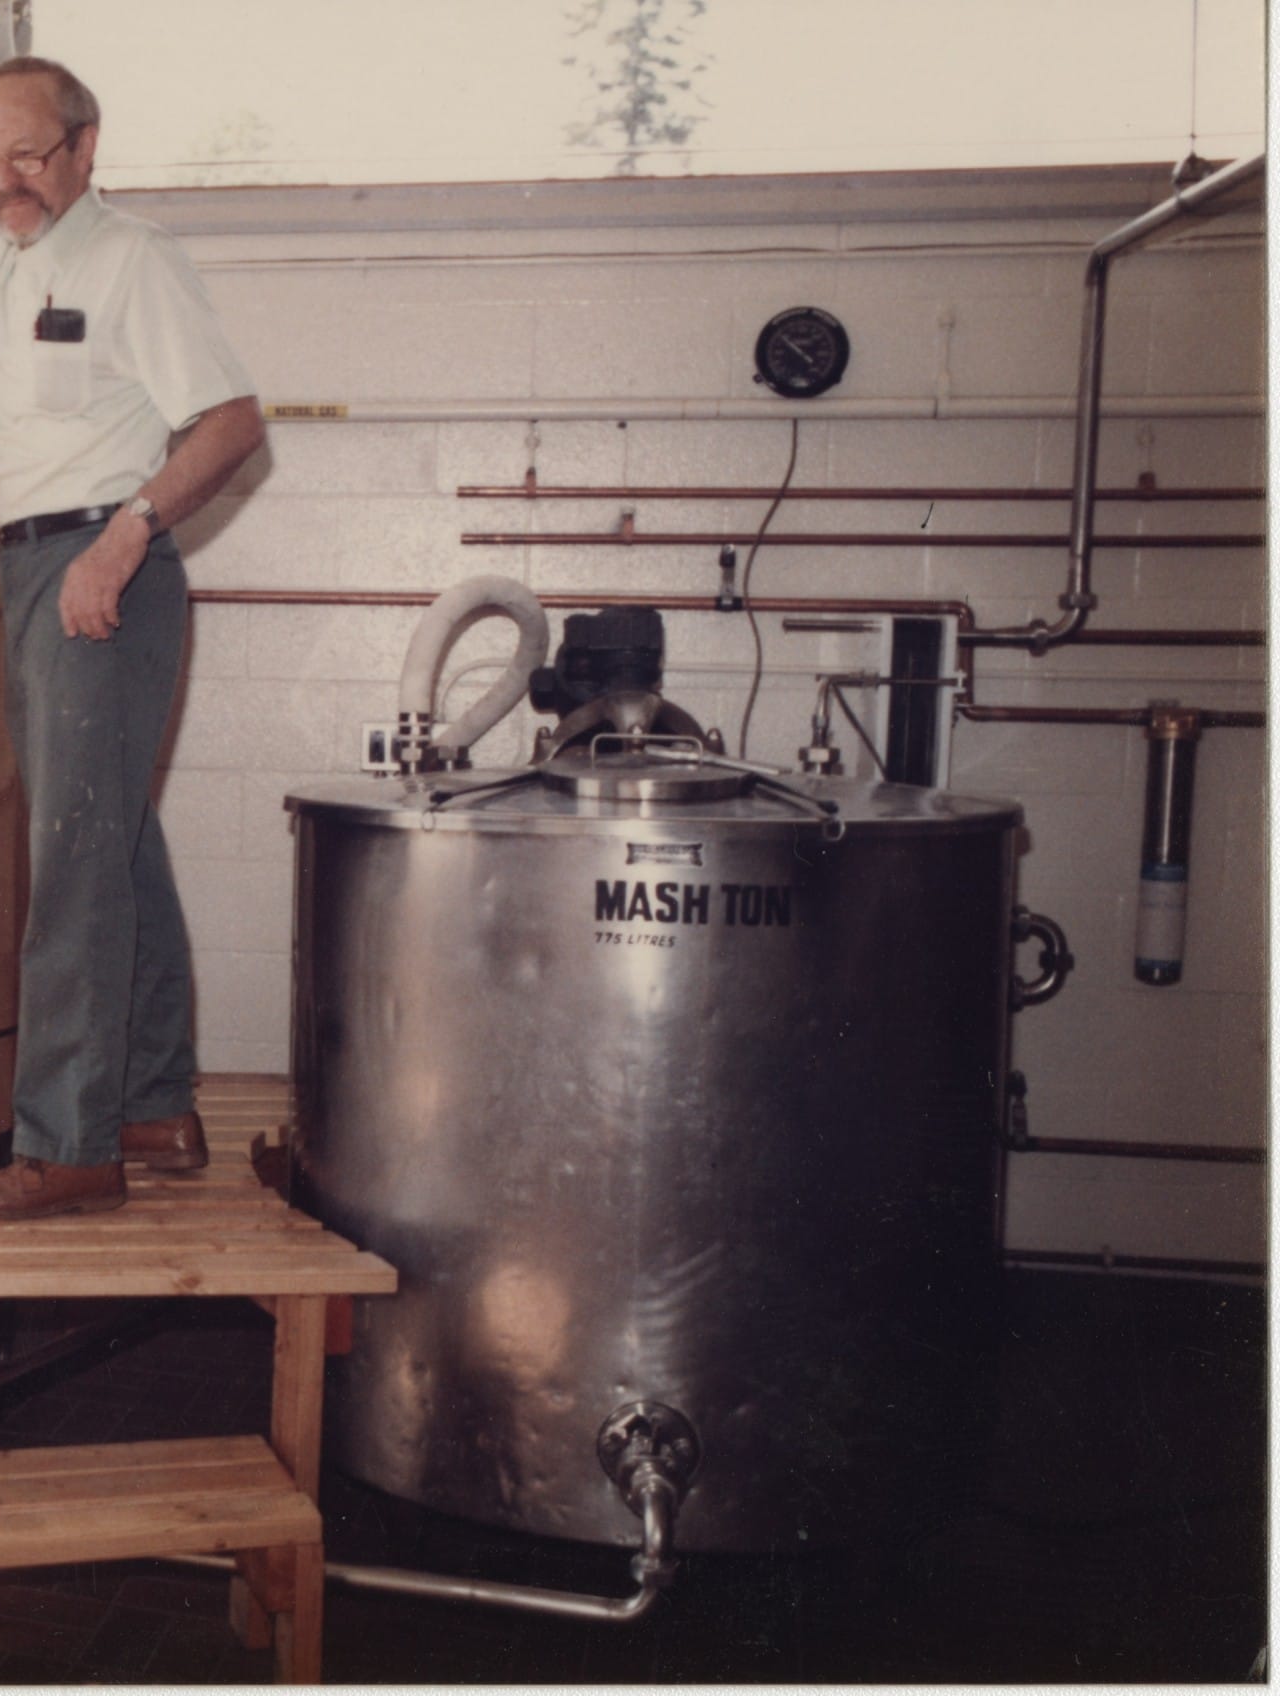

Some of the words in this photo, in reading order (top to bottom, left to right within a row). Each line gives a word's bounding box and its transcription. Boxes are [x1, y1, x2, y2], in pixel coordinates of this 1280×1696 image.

[594, 879, 711, 926] MASH
[721, 883, 793, 927] TON
[594, 931, 623, 945] 775
[626, 933, 677, 949] LITRES
